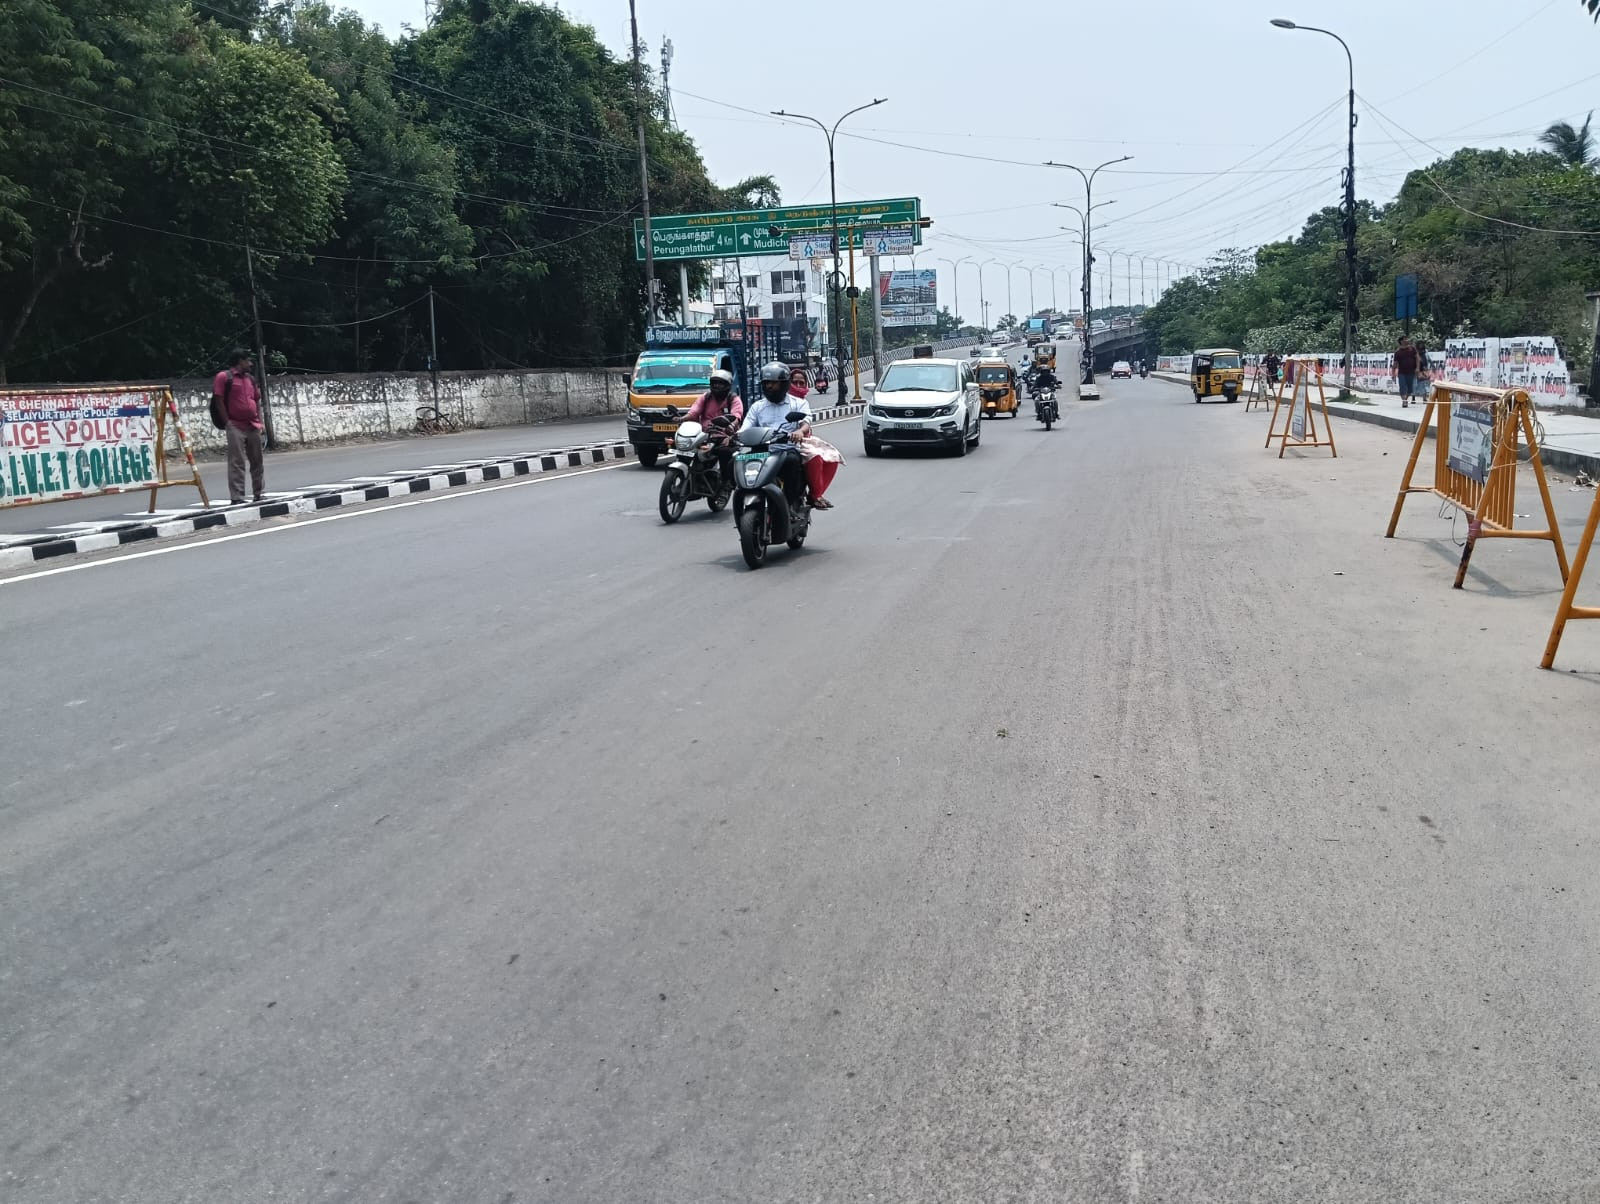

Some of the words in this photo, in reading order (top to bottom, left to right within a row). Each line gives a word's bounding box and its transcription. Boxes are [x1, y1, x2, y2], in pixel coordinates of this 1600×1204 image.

[717, 234, 723, 246] 4
[654, 242, 716, 255] Perungalathur
[7, 410, 53, 421] SELAIYUR
[54, 409, 89, 419] TRAFFIC
[91, 407, 118, 417] POLICE
[75, 444, 152, 488] COLLEGE
